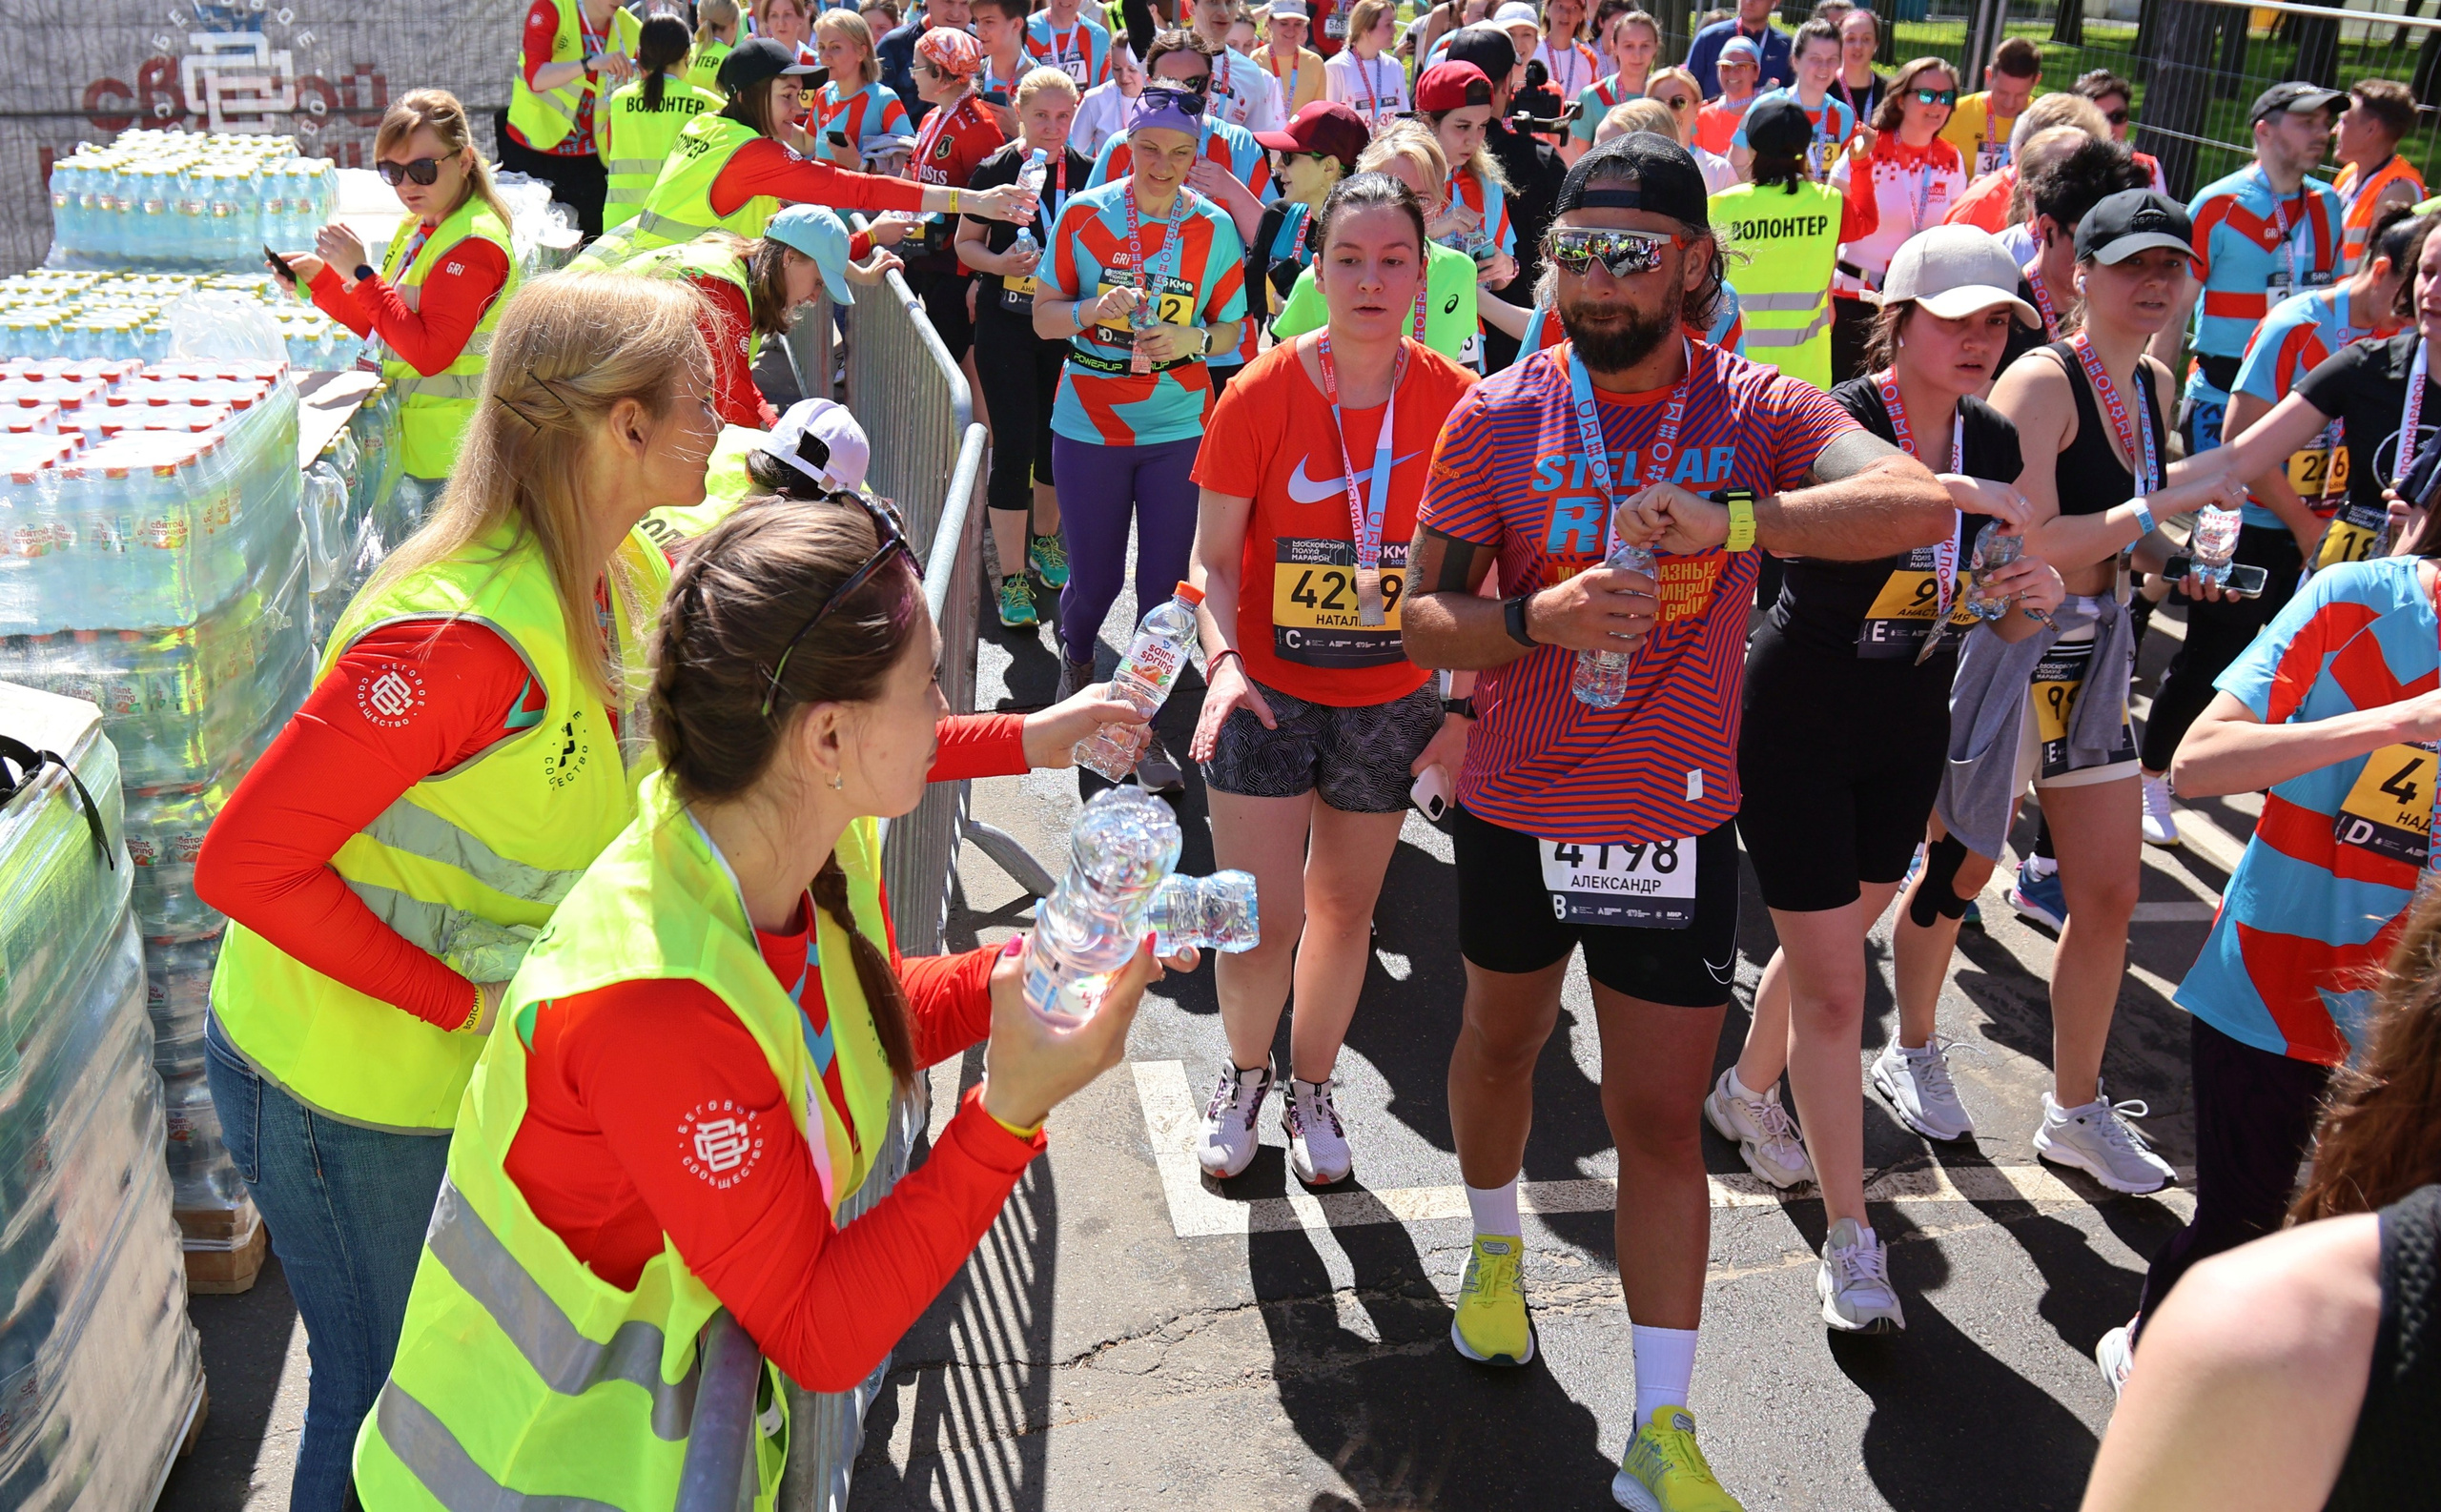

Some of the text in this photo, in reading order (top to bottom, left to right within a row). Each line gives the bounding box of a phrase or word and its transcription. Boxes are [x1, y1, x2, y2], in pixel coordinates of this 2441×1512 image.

[626, 96, 706, 114] ВООНТЕР
[446, 261, 465, 276] GRi
[1112, 252, 1131, 266] GRi
[2399, 373, 2428, 475] ПОЛУМАРАФОН
[1531, 446, 1735, 492] STELAR
[1292, 540, 1345, 550] МОСКОВСКИЙ
[1316, 614, 1376, 627] НАТАЛ
[1872, 621, 1888, 642] E
[1140, 649, 1175, 674] spring
[1148, 644, 1177, 664] saint
[381, 663, 426, 707] БЕГОВОЕ
[358, 677, 410, 728] СООБЩЕСТВО
[2048, 742, 2057, 763] E
[2345, 819, 2374, 844] D
[1570, 874, 1662, 894] АЛЕКСАНДР
[1553, 894, 1567, 920] B
[677, 1099, 757, 1134] БЕГОВОЕ
[682, 1138, 764, 1190] СООБЩЕСТВО
